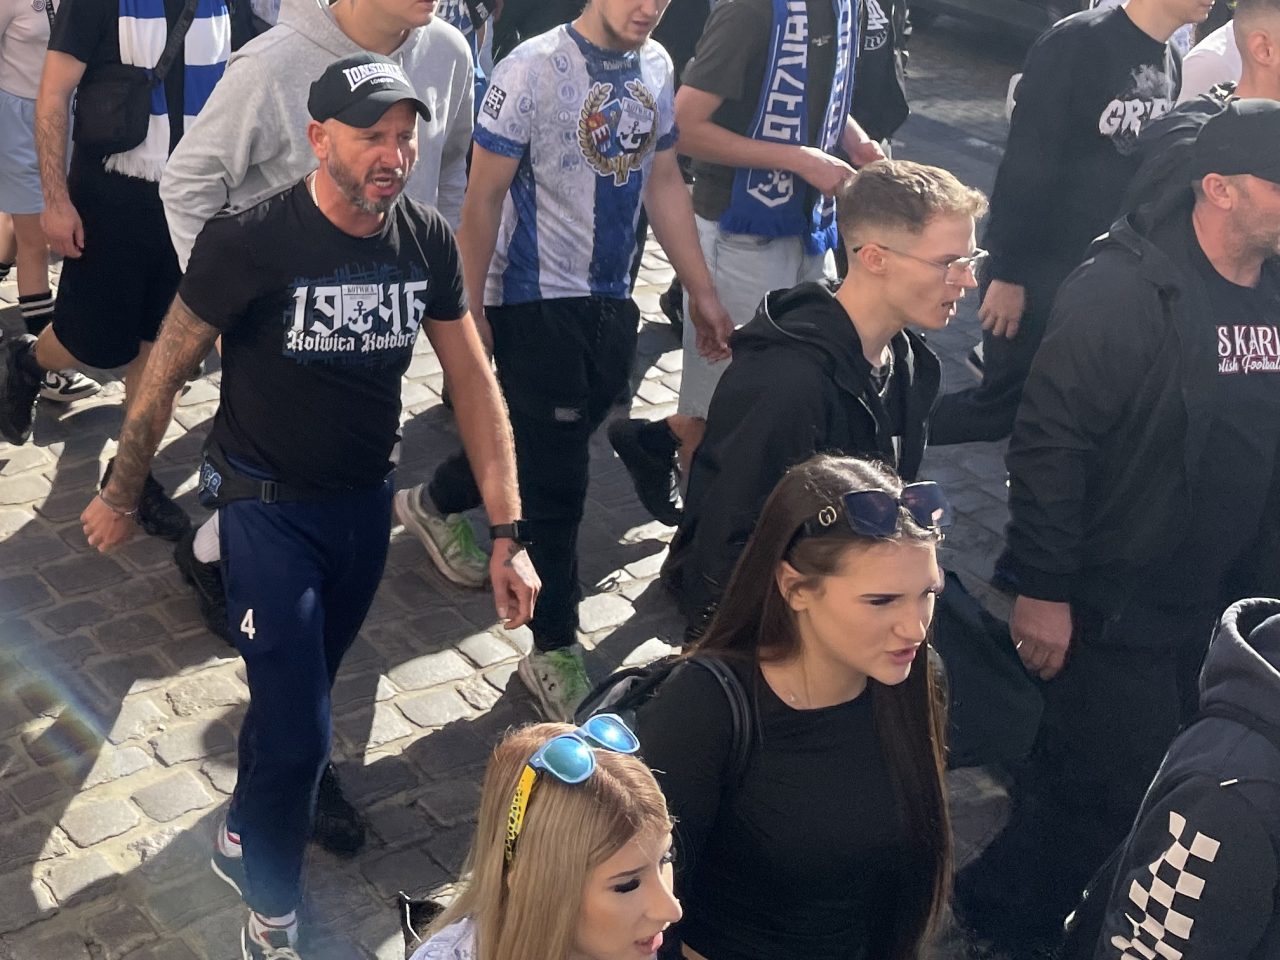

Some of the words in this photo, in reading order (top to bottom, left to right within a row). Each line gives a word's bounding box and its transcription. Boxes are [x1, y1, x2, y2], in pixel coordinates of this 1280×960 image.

[342, 62, 410, 92] LONSDALE
[287, 329, 355, 352] Kotwica
[240, 608, 256, 640] 4
